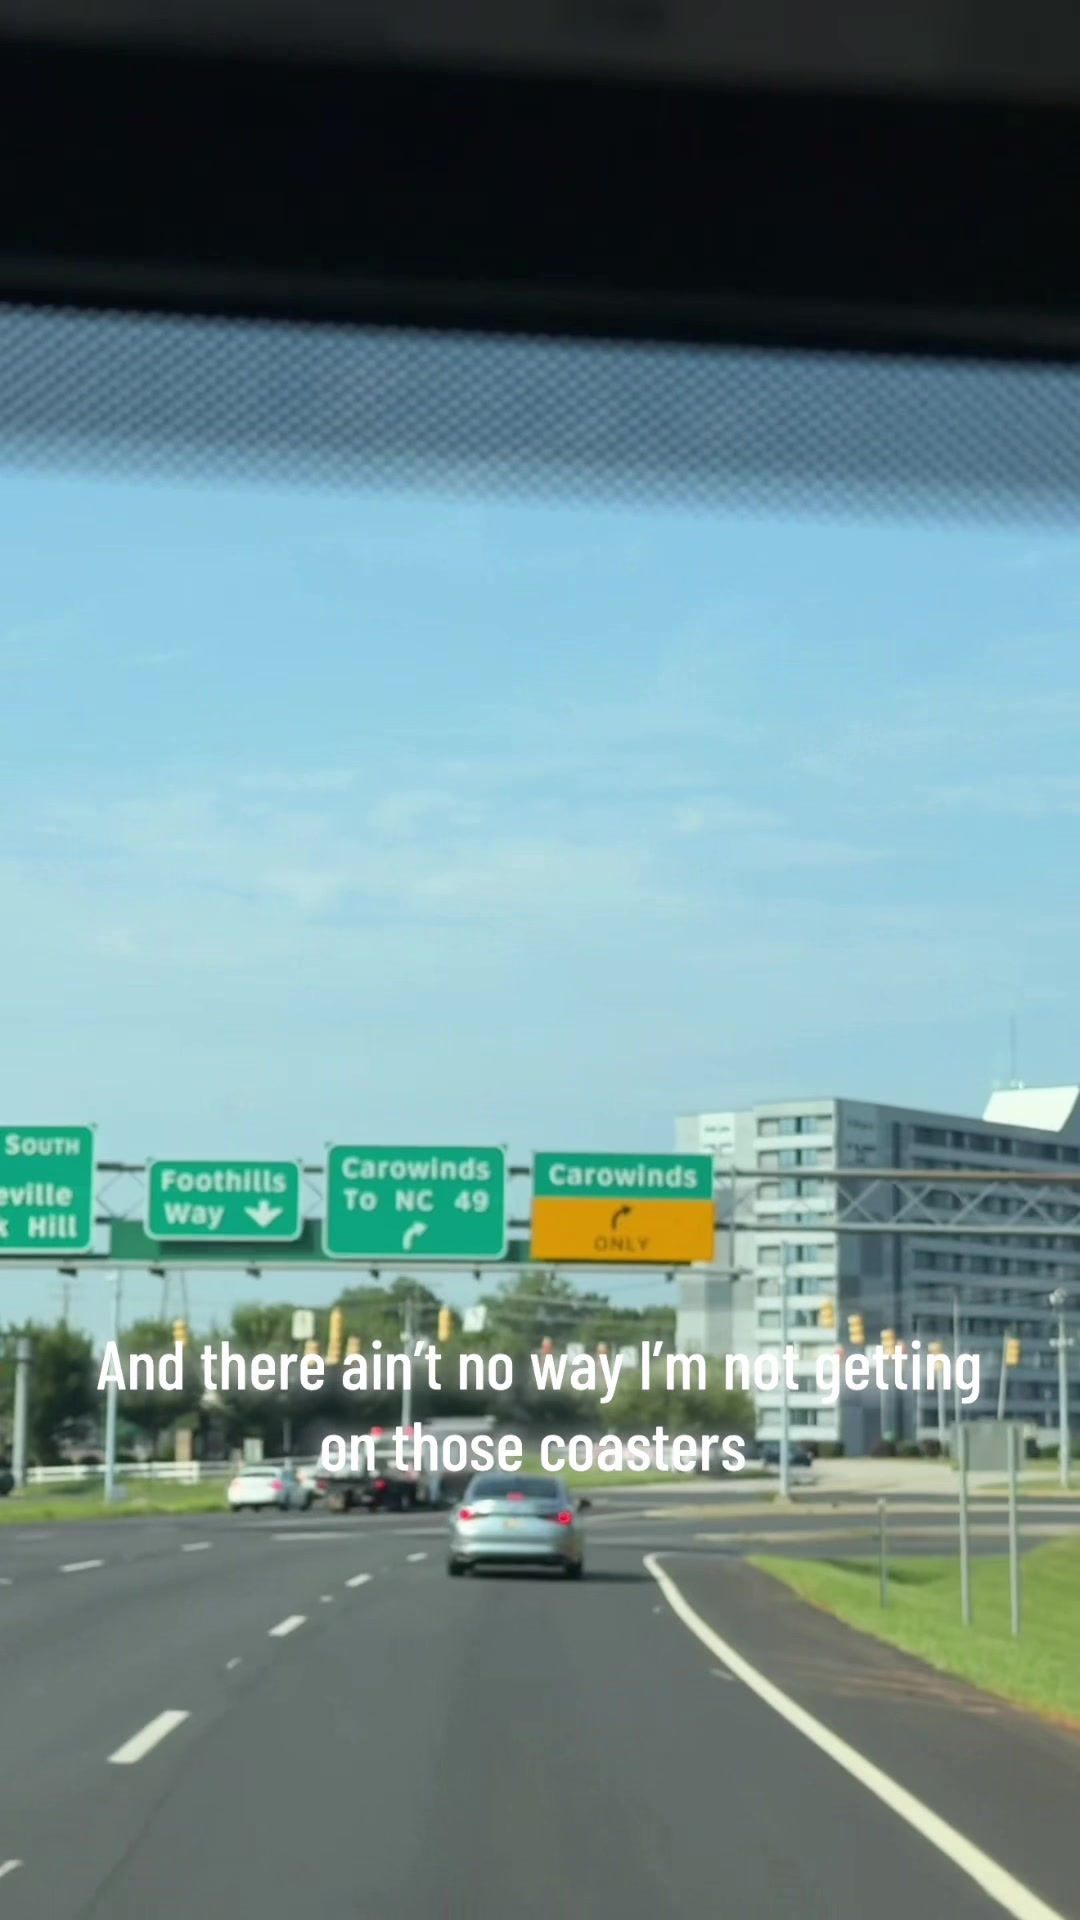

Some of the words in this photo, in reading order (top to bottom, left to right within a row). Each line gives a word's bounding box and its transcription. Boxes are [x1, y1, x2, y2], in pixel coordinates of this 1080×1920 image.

[4, 1132, 80, 1156] SOUTH
[161, 1168, 287, 1194] Foothills
[341, 1156, 491, 1182] Carowinds
[548, 1162, 698, 1189] Carowinds
[343, 1188, 378, 1211] To
[395, 1190, 434, 1212] NC
[454, 1189, 490, 1213] 49
[28, 1213, 78, 1239] Hill
[164, 1202, 225, 1230] Way
[593, 1235, 649, 1253] ONLY
